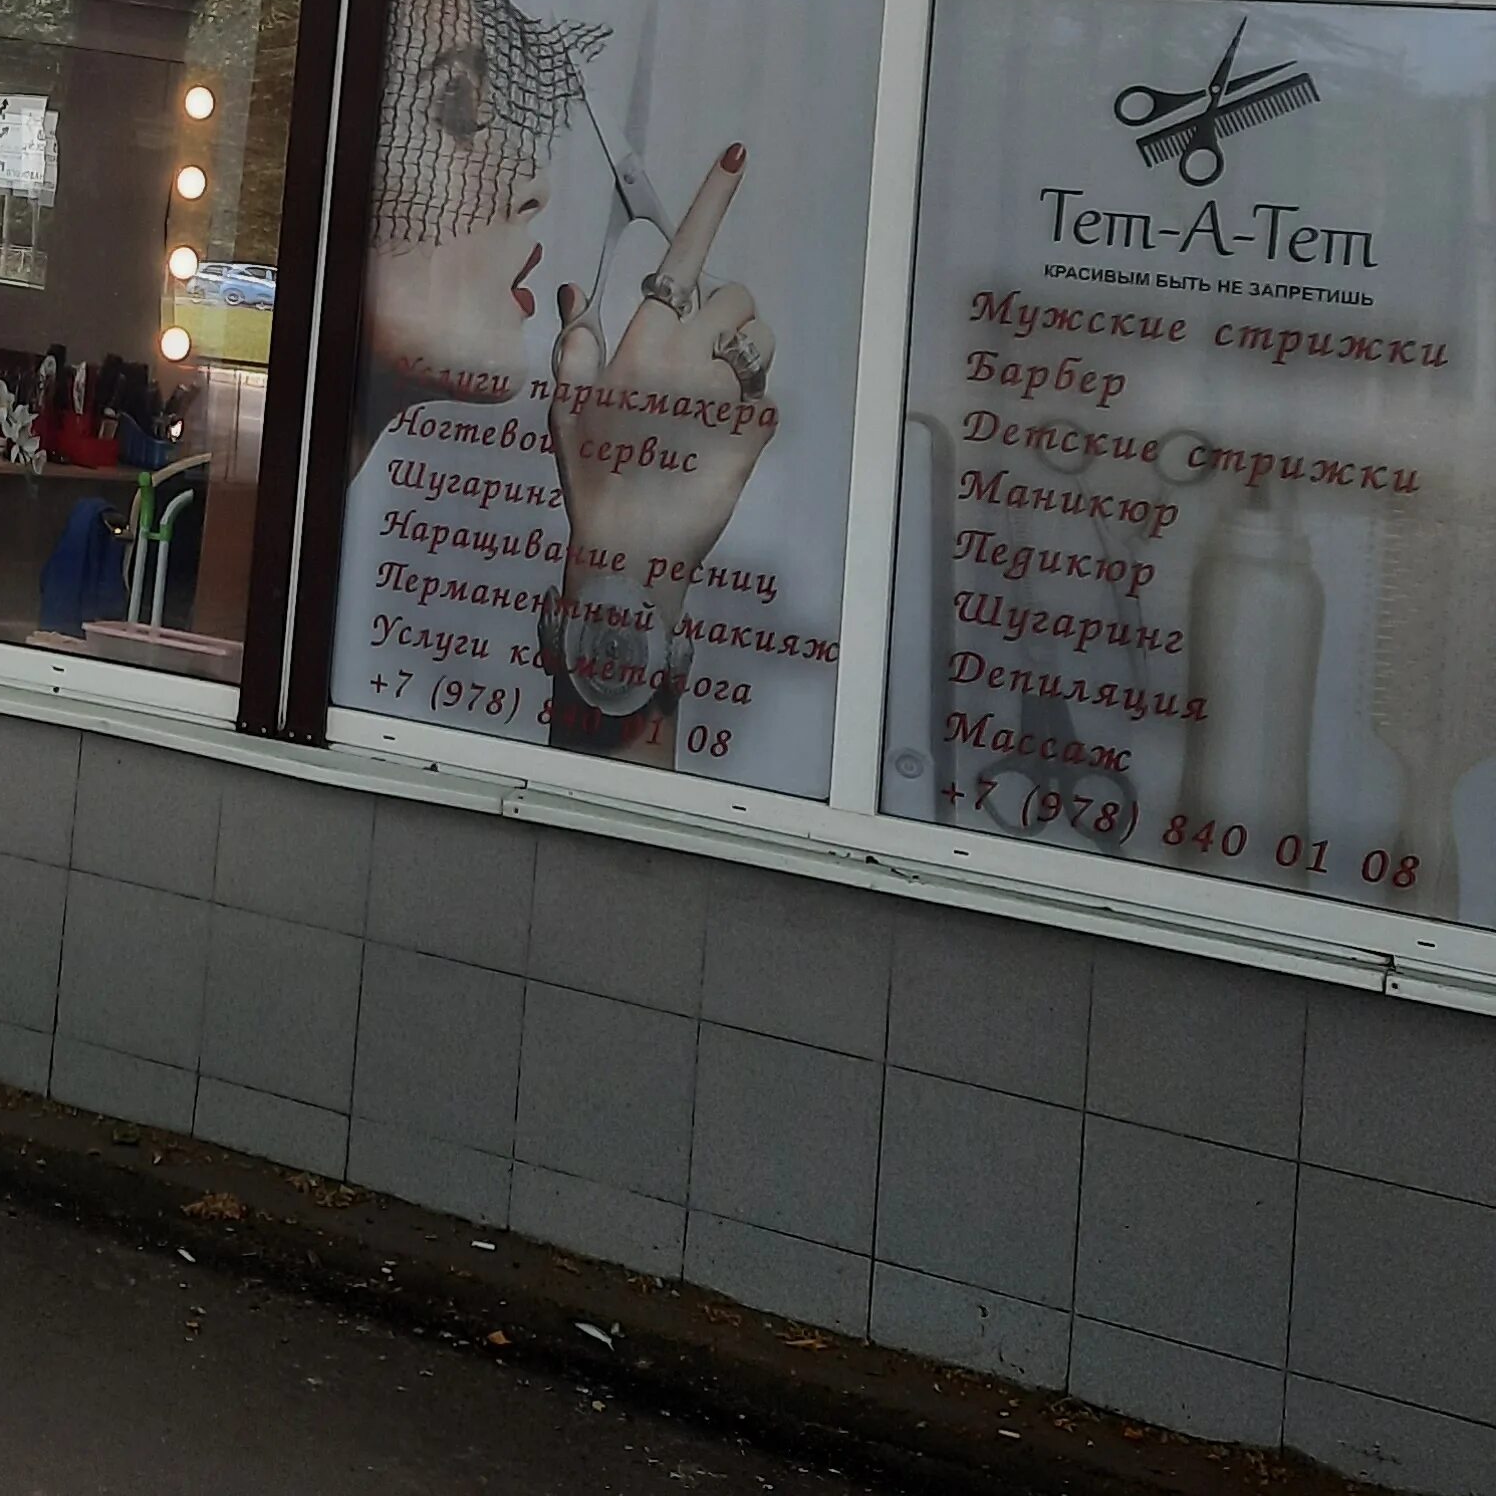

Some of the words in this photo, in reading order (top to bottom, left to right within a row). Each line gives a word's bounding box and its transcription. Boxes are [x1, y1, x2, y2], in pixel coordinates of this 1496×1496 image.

[1043, 262, 1151, 288] КРАСИВЫМ
[1155, 272, 1211, 293] БЫТЬ
[1217, 278, 1244, 297] НЕ
[1248, 280, 1375, 307] ЗАПРЕТИШЬ
[969, 290, 1188, 344] Мужские
[1214, 319, 1449, 368] стрижки
[528, 377, 780, 436] парикмахера
[966, 350, 1128, 409] Барбер
[387, 459, 565, 511] Шугаринг
[578, 435, 700, 476] сервис
[963, 409, 1160, 465] Детские
[1187, 439, 1422, 495] стрижки
[957, 468, 1181, 540] Маникюр
[379, 509, 627, 574] Наращивание
[643, 554, 779, 604] ресниц
[952, 529, 1157, 599] Педикюр
[369, 614, 490, 662] Услуги
[375, 561, 656, 633] Перманентный
[670, 615, 841, 664] макияж
[952, 590, 1185, 655] Шугаринг
[429, 674, 522, 725] (978)
[688, 724, 734, 759] 08
[948, 650, 1210, 723] Депиляция
[944, 710, 1134, 774] Массаж
[1020, 782, 1141, 847] (978)
[1161, 813, 1249, 859] 840
[1275, 833, 1331, 875] 01
[1361, 848, 1422, 890] 08
